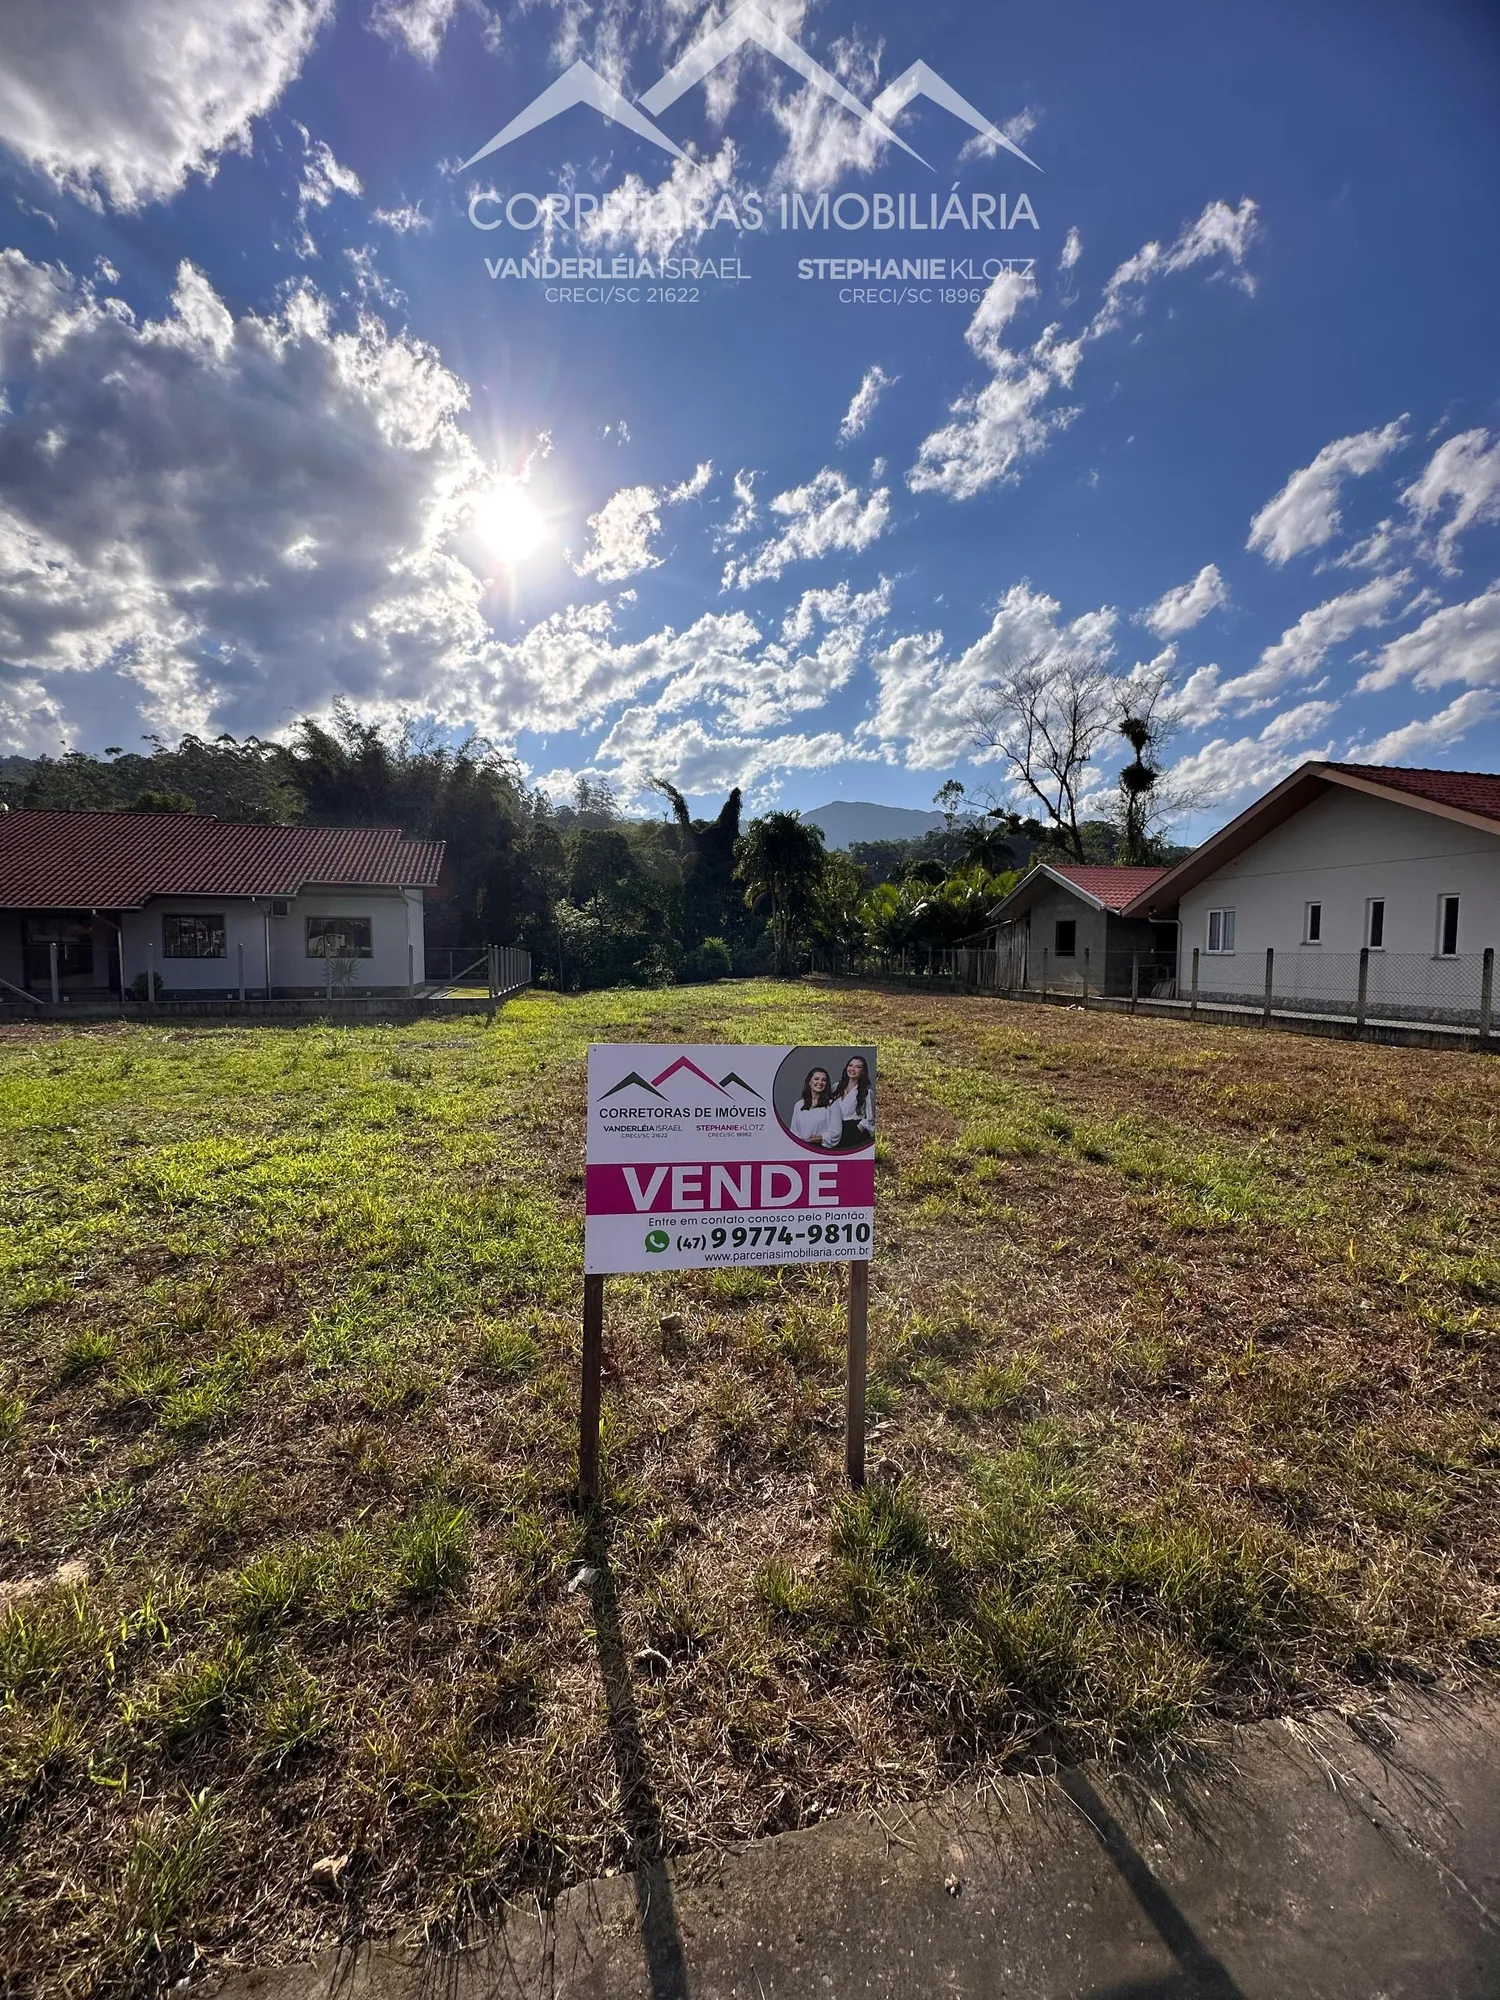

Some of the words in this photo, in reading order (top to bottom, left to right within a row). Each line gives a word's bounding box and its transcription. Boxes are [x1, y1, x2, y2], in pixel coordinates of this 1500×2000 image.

[600, 1107, 691, 1119] CORRETORAS
[694, 1107, 712, 1118] DE
[715, 1104, 767, 1118] IMÓVEIS
[622, 1163, 840, 1212] VENDE
[648, 1217, 677, 1227] Entre
[680, 1217, 698, 1226] em
[701, 1214, 745, 1225] contato
[748, 1214, 795, 1223] conosco
[798, 1212, 822, 1223] pelo
[825, 1211, 868, 1221] Plantão:
[676, 1235, 707, 1252] (47)
[704, 1245, 869, 1263] www.parceriasimobiliaria.com.br
